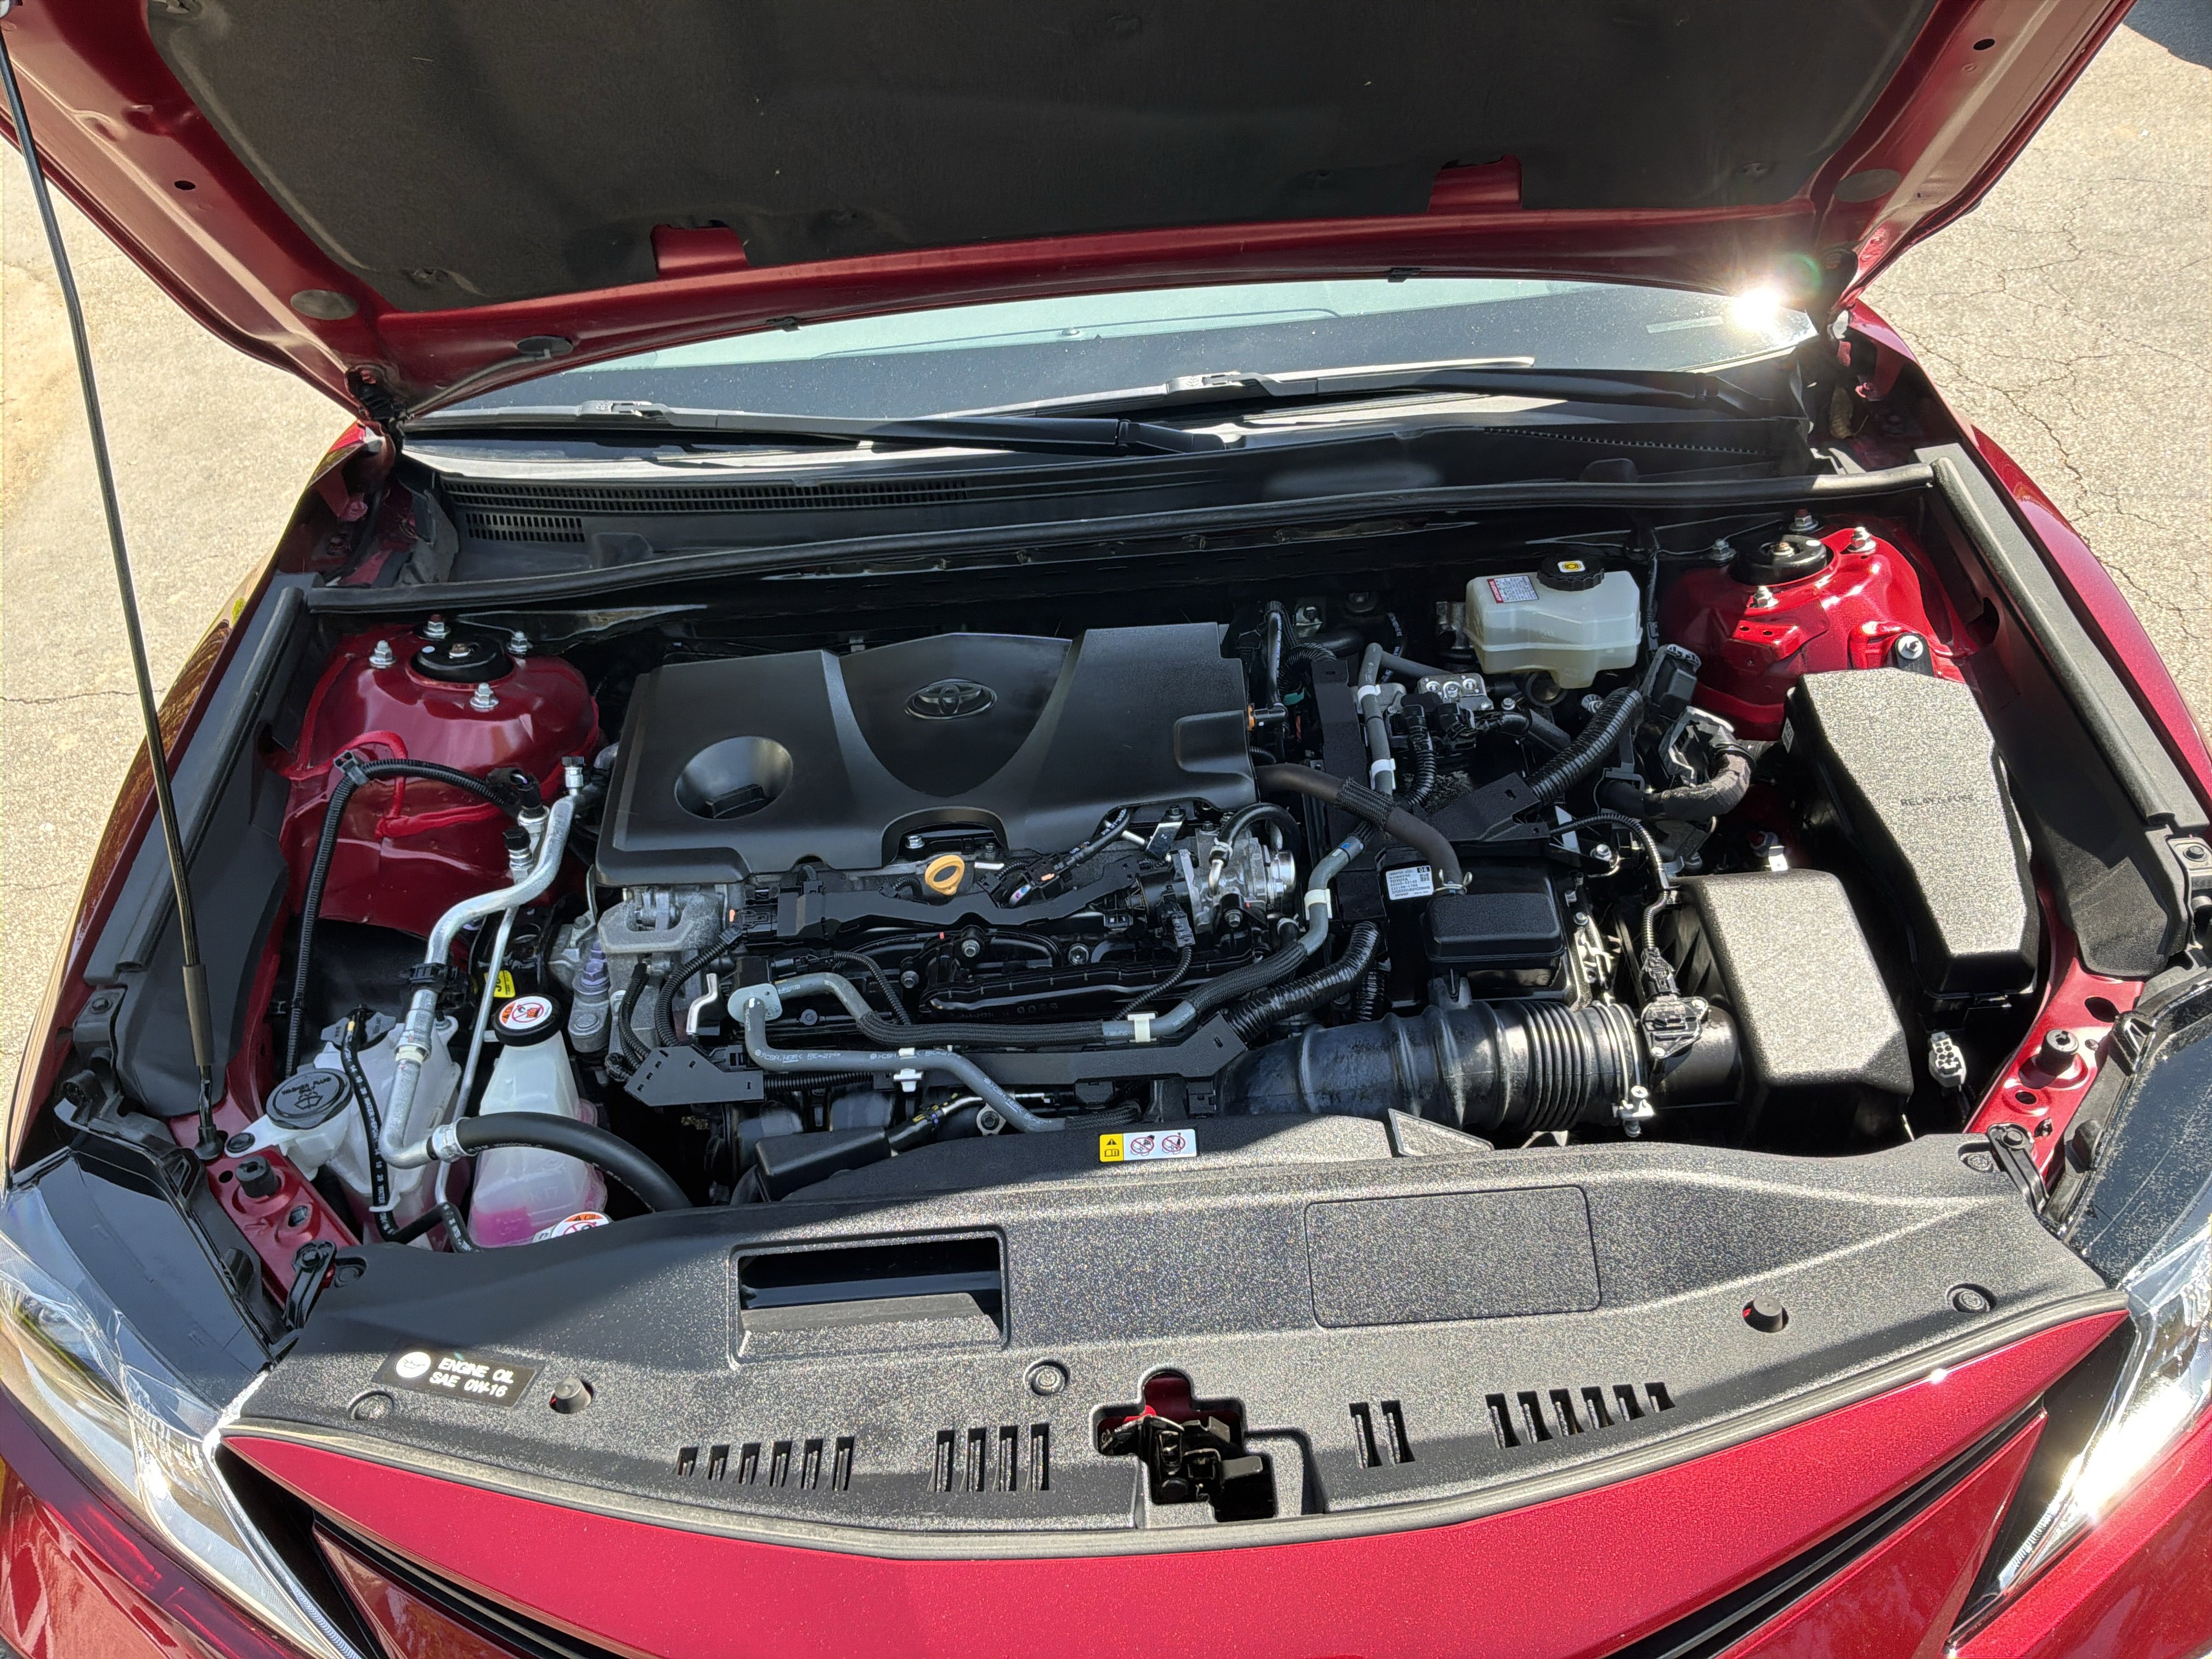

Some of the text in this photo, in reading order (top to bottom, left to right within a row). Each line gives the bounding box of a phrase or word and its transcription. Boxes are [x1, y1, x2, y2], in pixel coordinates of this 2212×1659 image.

[437, 1357, 514, 1384] ENGINE OIL
[429, 1372, 508, 1397] SAE 0W-16
